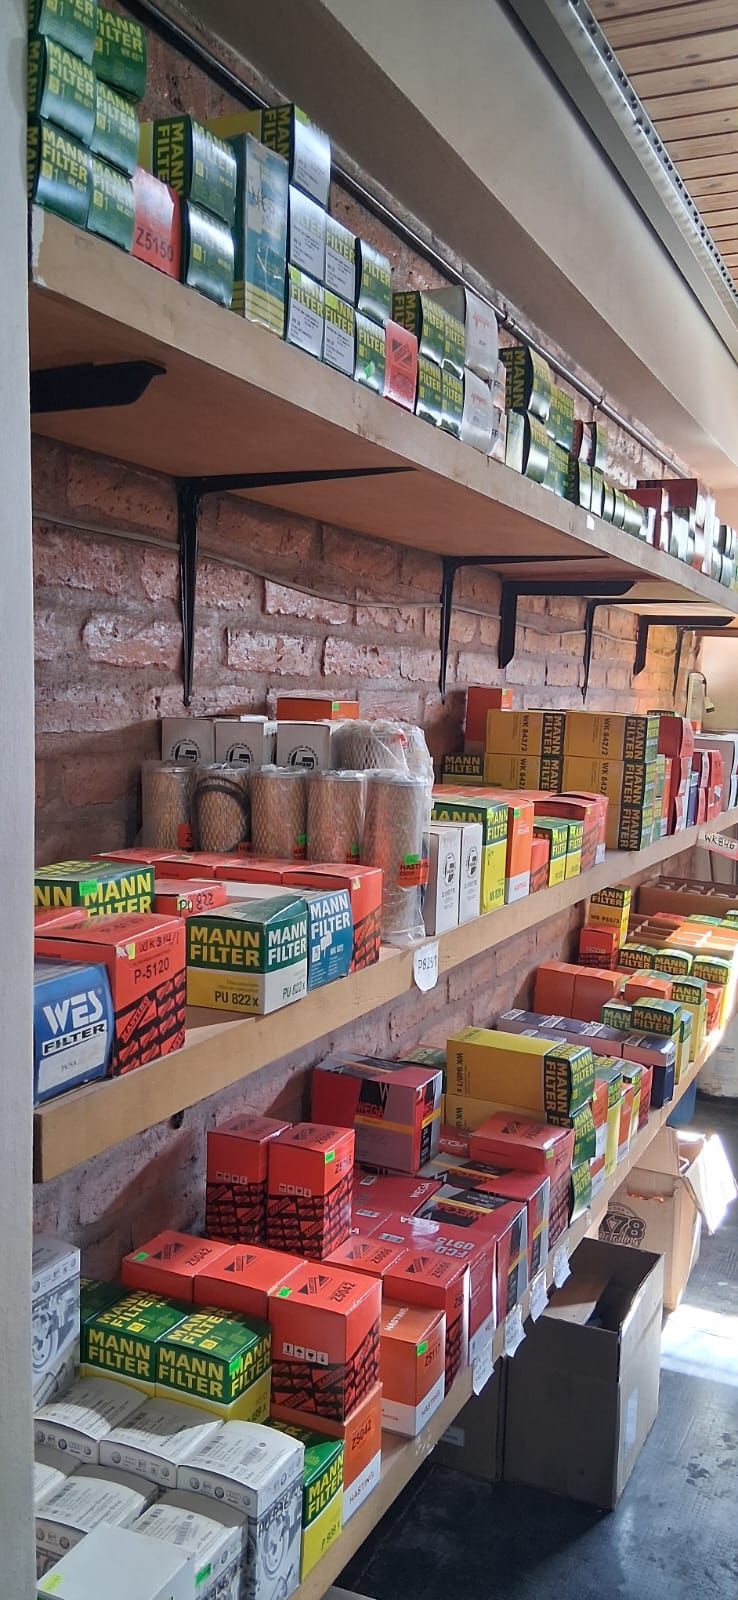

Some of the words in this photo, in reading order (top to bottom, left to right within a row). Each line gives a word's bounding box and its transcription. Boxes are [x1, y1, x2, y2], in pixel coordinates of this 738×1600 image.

[97, 20, 143, 52] ILTER
[49, 40, 94, 84] MANN
[49, 57, 94, 100] FILTER
[263, 109, 277, 150] FILT
[277, 108, 291, 159] MAN
[42, 126, 88, 167] MANN
[157, 124, 171, 183] FILTE
[171, 123, 185, 197] MANN
[42, 143, 89, 184] FILTER
[136, 226, 175, 264] Z5150
[363, 260, 391, 288] FILTER
[291, 286, 323, 317] FILTER
[405, 294, 417, 335] MAN
[325, 305, 354, 337] FILTER
[359, 330, 386, 358] FILTER
[514, 351, 526, 408] MANN
[542, 715, 553, 755] FILTER
[553, 715, 563, 755] MANN
[625, 718, 636, 760] FILTER
[634, 718, 646, 761] MANN
[444, 755, 481, 766] MANN
[444, 764, 481, 775] FILTER
[539, 758, 550, 790] FILTE
[622, 763, 635, 809] FILTER
[631, 763, 645, 806] MANN
[487, 823, 508, 841] FILTER
[619, 808, 632, 848] FILTER
[627, 808, 640, 849] MANN
[35, 886, 73, 908] NN
[85, 872, 152, 907] MANN
[196, 892, 215, 911] 822
[591, 895, 623, 907] FILTER
[311, 894, 350, 921] MANN
[190, 925, 260, 948] MANN
[268, 919, 307, 948] MANN
[311, 911, 352, 940] FILTER
[190, 943, 260, 967] FILTER
[268, 937, 307, 966] FILTER
[620, 951, 651, 963] MANN
[620, 958, 650, 969] FILTER
[655, 956, 687, 969] MANN
[134, 956, 171, 985] P-5120
[654, 964, 686, 976] FILTER
[693, 963, 727, 977] MANN
[42, 989, 104, 1036] WES
[214, 990, 229, 1004] PU
[231, 992, 252, 1007] 822
[672, 991, 700, 1004] ILTER
[603, 1018, 631, 1031] FILTE
[604, 1008, 631, 1021] MAN
[633, 1018, 671, 1033] FILTER
[634, 1009, 672, 1025] MANN
[43, 1023, 105, 1055] FILTER
[571, 1053, 593, 1072] MANN
[572, 1064, 595, 1087] FILTER
[545, 1060, 556, 1112] FILTER
[556, 1061, 569, 1114] MANN
[575, 1118, 595, 1140] FILTER
[185, 1248, 213, 1267] Z5042
[96, 1289, 147, 1325] MANN
[331, 1280, 357, 1304] Z5042
[110, 1292, 162, 1328] FILTER
[166, 1305, 218, 1341] MANN
[180, 1307, 233, 1345] FILTER
[89, 1328, 151, 1360] MANN
[88, 1345, 150, 1377] FILTER
[158, 1346, 224, 1382] MANN
[231, 1350, 272, 1397] FILTER
[158, 1364, 223, 1398] FILTER
[351, 1418, 372, 1450] Z5042
[308, 1450, 344, 1501] MANN
[307, 1466, 344, 1521] FILTER
